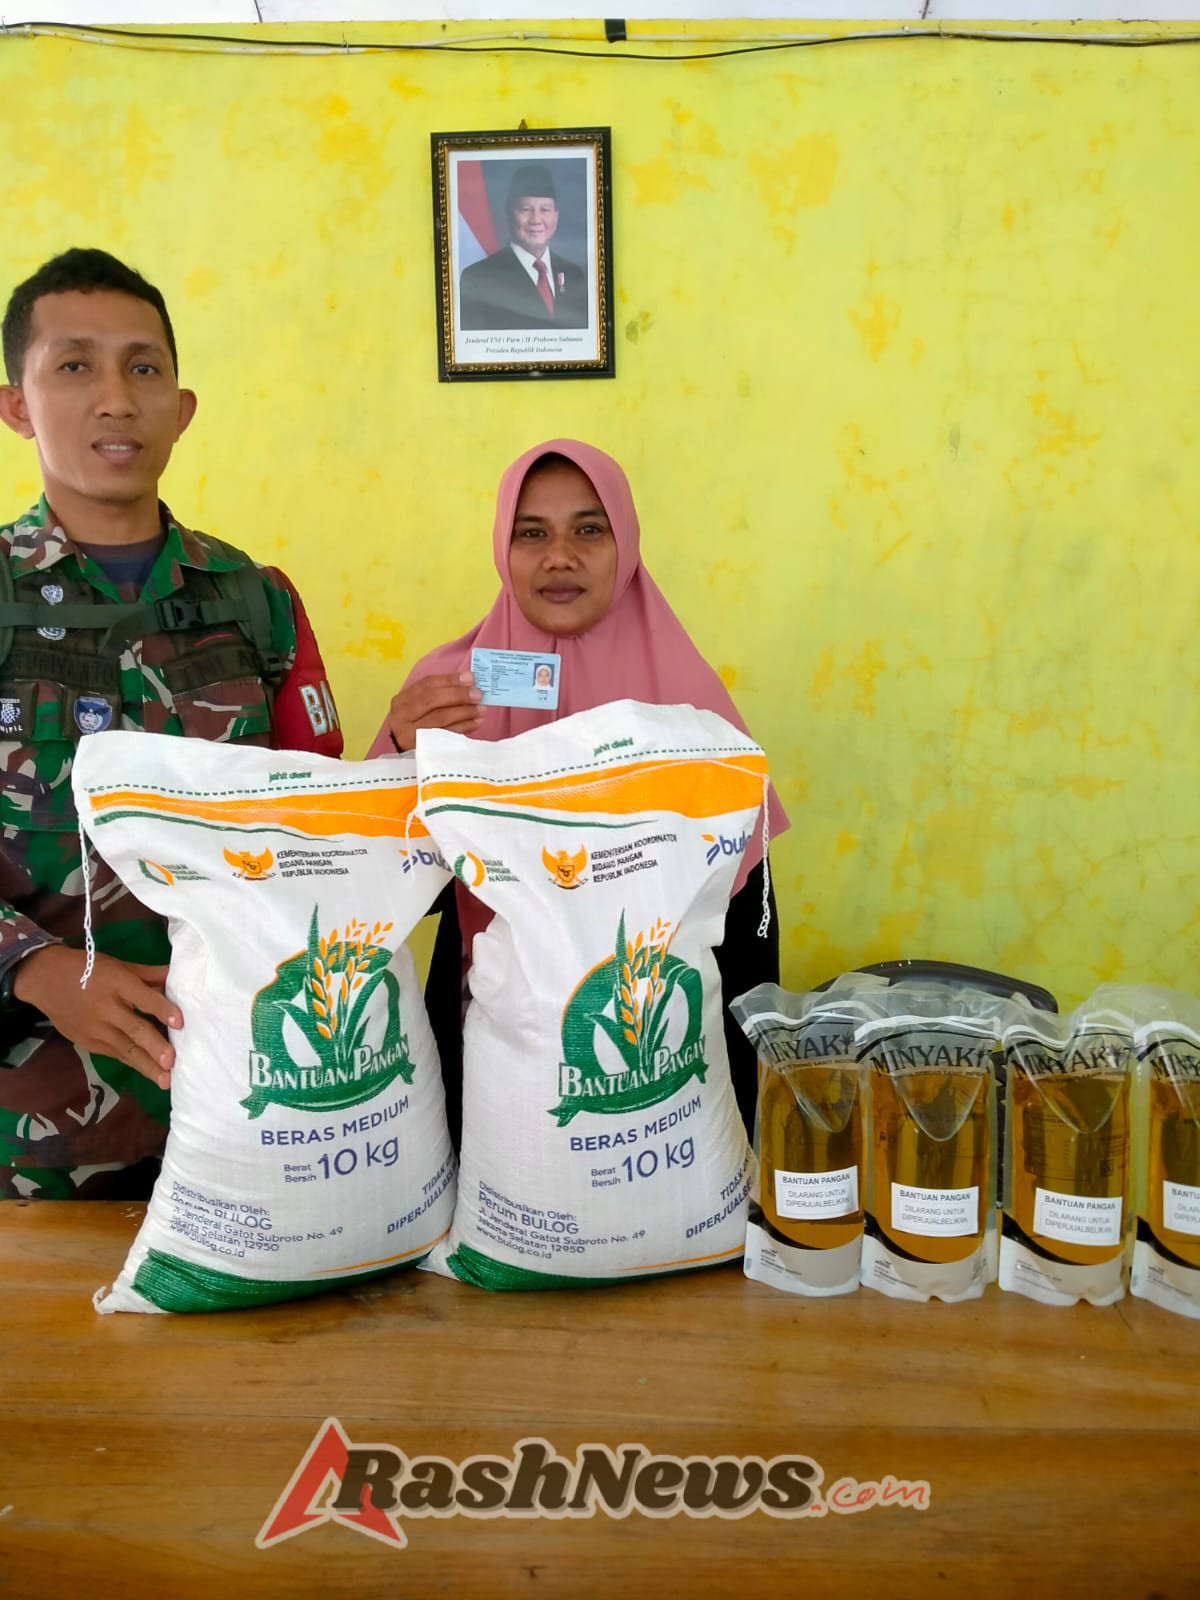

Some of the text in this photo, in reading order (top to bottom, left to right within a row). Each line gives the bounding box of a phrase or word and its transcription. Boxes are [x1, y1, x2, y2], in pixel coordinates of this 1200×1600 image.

[591, 833, 678, 860] KEMENTERIAN KOORDINATOR
[617, 851, 643, 866] PANGAN
[593, 858, 658, 882] REPUBLIK INDONESIA
[250, 1034, 410, 1090] BANTUAN PANGAN
[559, 1034, 706, 1097] BANTUAN PANGAN
[260, 1094, 410, 1146] BERAS MEDIUM
[570, 1095, 702, 1151] BERAS MEDIUM
[284, 1163, 312, 1172] Berat
[317, 1136, 399, 1180] 10 kg
[622, 1136, 695, 1182] 10 kg
[284, 1173, 317, 1183] Bersih
[591, 1166, 616, 1177] Berat
[782, 1173, 850, 1185] BANTUAN PANGAN
[591, 1177, 621, 1188] Bersih
[720, 1168, 744, 1201] TIDAK
[479, 1180, 577, 1222] Didistribusikan Oleh:
[785, 1197, 850, 1207] DIPERJUALBELIKAN
[788, 1188, 847, 1199] DILARANG UNTUK
[899, 1189, 971, 1202] BANTUAN PANGAN
[1044, 1195, 1116, 1210] BANTUAN PANGAN
[240, 1203, 270, 1216] Oleh:
[479, 1190, 580, 1235] Perum BULOG
[904, 1204, 966, 1216] DILARANG UNTUK
[1049, 1210, 1110, 1224] DILARANG UNTUK
[202, 1225, 241, 1247] Selatan
[244, 1239, 280, 1252] 12950
[224, 1225, 254, 1240] Gatot
[257, 1233, 304, 1243] Subroto
[489, 1212, 528, 1237] Jenderal
[530, 1231, 561, 1244] Gatot
[610, 1234, 628, 1245] No.
[632, 1229, 646, 1240] 49
[509, 1232, 548, 1251] Selatan
[551, 1243, 586, 1255] 12950
